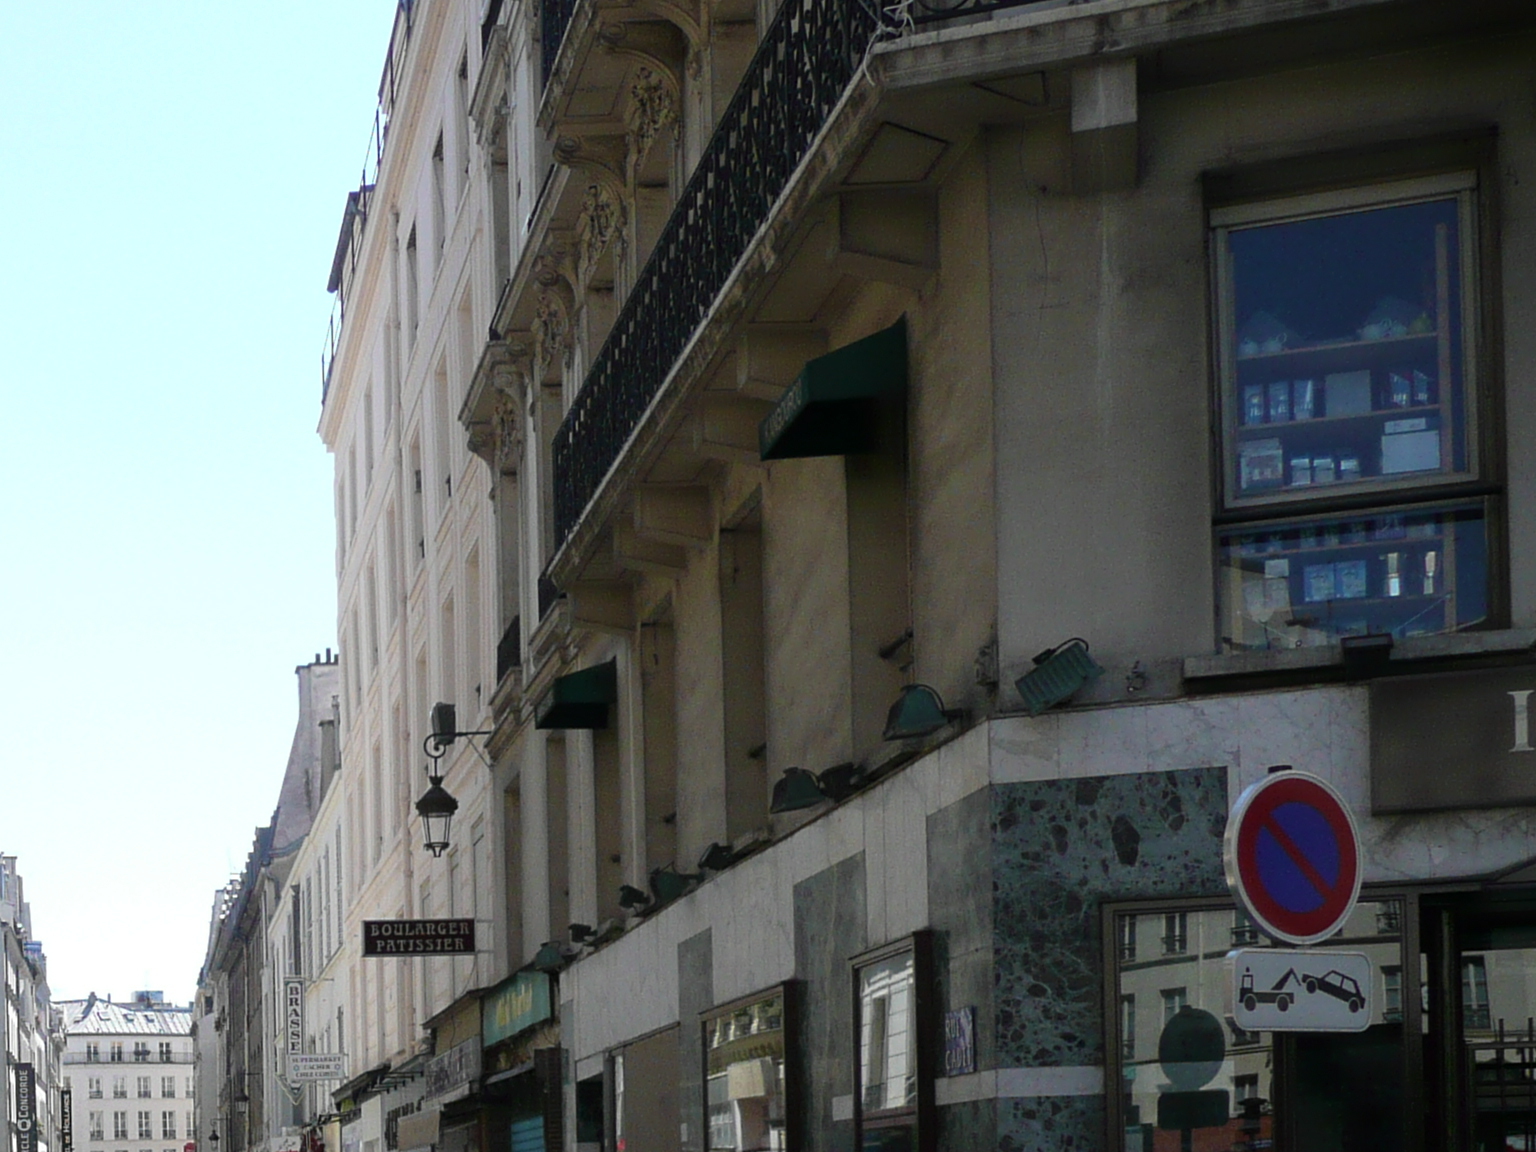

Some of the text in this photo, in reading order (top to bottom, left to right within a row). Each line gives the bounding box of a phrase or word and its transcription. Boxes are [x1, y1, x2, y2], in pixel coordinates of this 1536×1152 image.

[370, 921, 470, 937] BOULANGER
[376, 937, 465, 953] PATISSIER
[18, 1069, 29, 1118] CONCORDE
